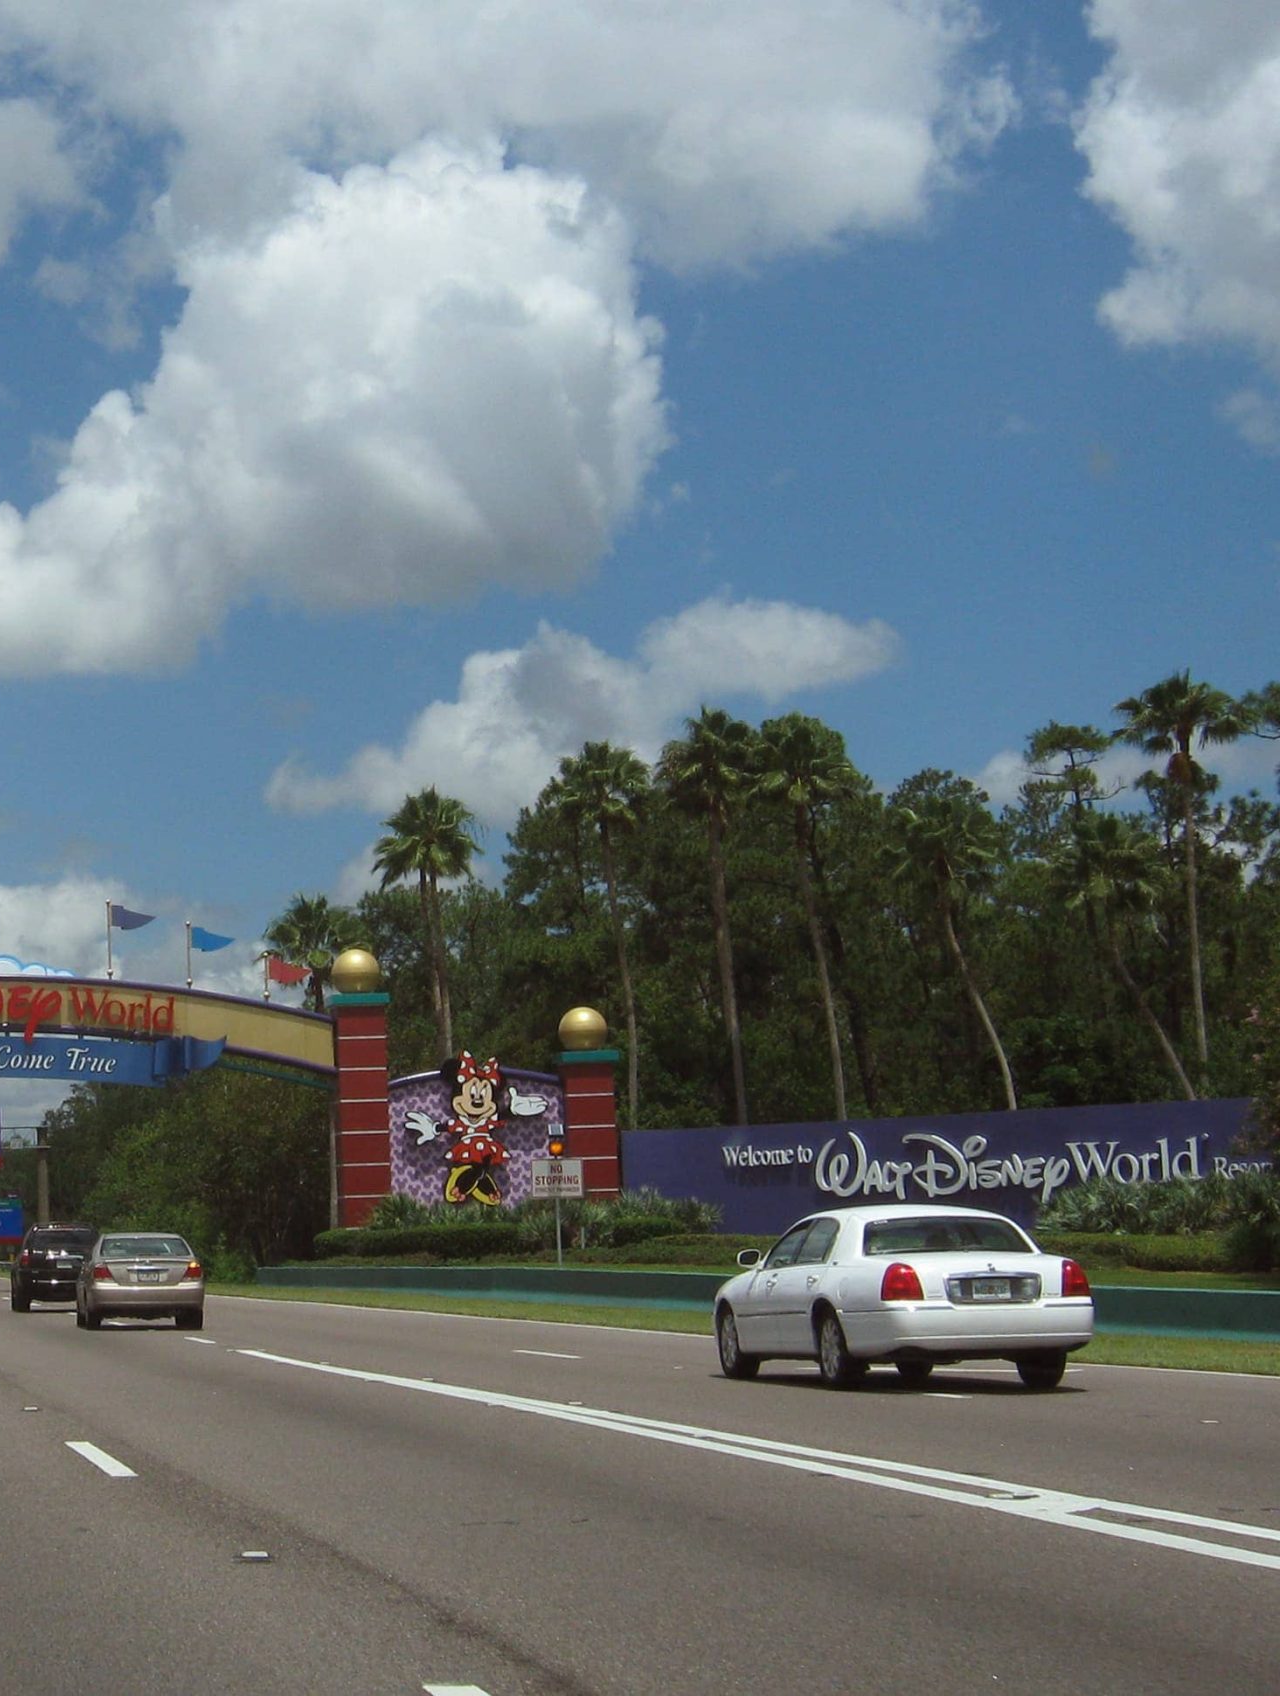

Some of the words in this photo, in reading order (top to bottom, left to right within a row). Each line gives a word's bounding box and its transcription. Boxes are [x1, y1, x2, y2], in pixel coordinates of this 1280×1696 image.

[69, 986, 176, 1034] World
[66, 1047, 117, 1074] True
[550, 1163, 563, 1174] NO
[722, 1145, 795, 1168] Welcome
[797, 1144, 814, 1164] to
[1064, 1136, 1204, 1185] World
[535, 1175, 580, 1185] STOPPING
